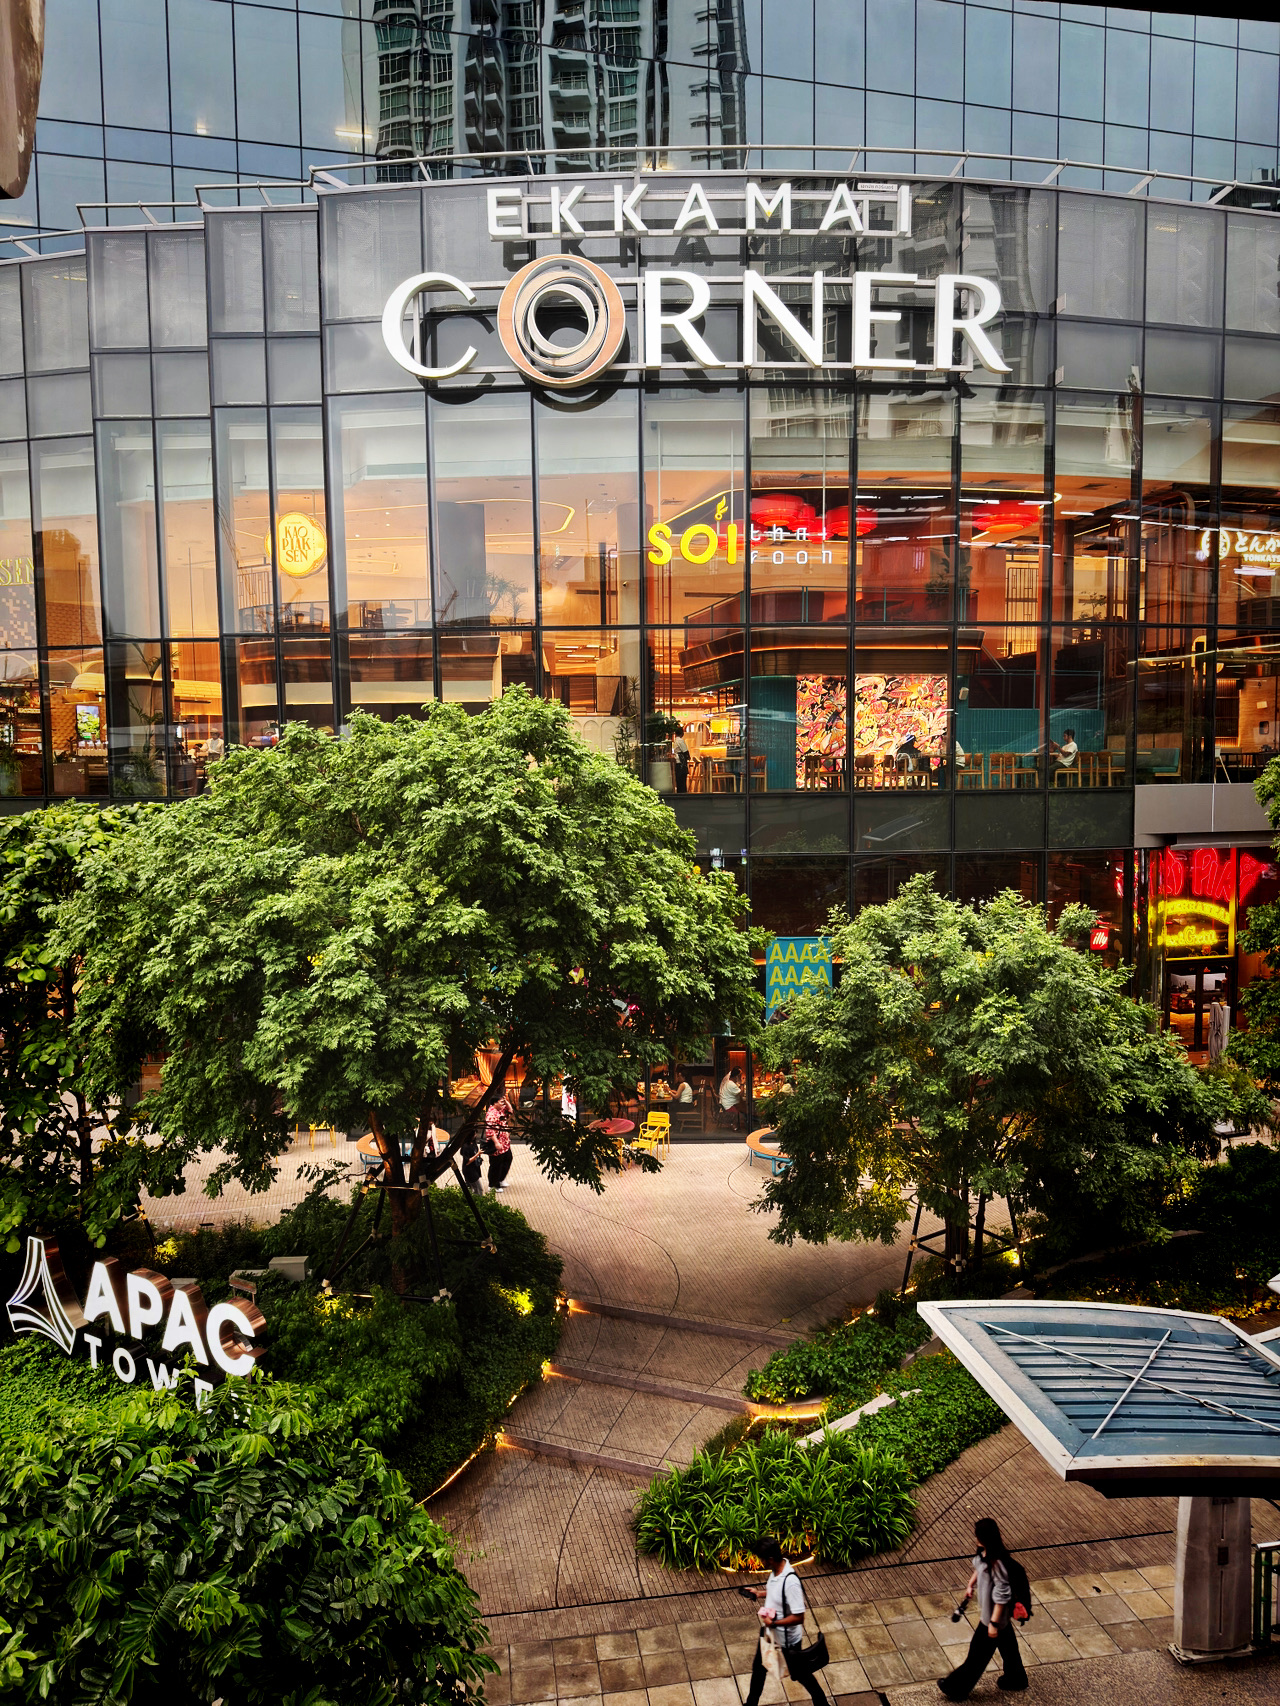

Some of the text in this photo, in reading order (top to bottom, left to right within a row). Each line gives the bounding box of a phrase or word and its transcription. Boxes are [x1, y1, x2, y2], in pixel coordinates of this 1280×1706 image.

[487, 183, 912, 240] EKKAMAI
[382, 254, 1012, 388] CORNER
[282, 538, 311, 550] PIAK
[284, 526, 308, 538] KAO
[647, 522, 738, 566] SOI
[285, 550, 308, 562] SEN
[1092, 932, 1108, 948] illy
[84, 1261, 256, 1377] APAC
